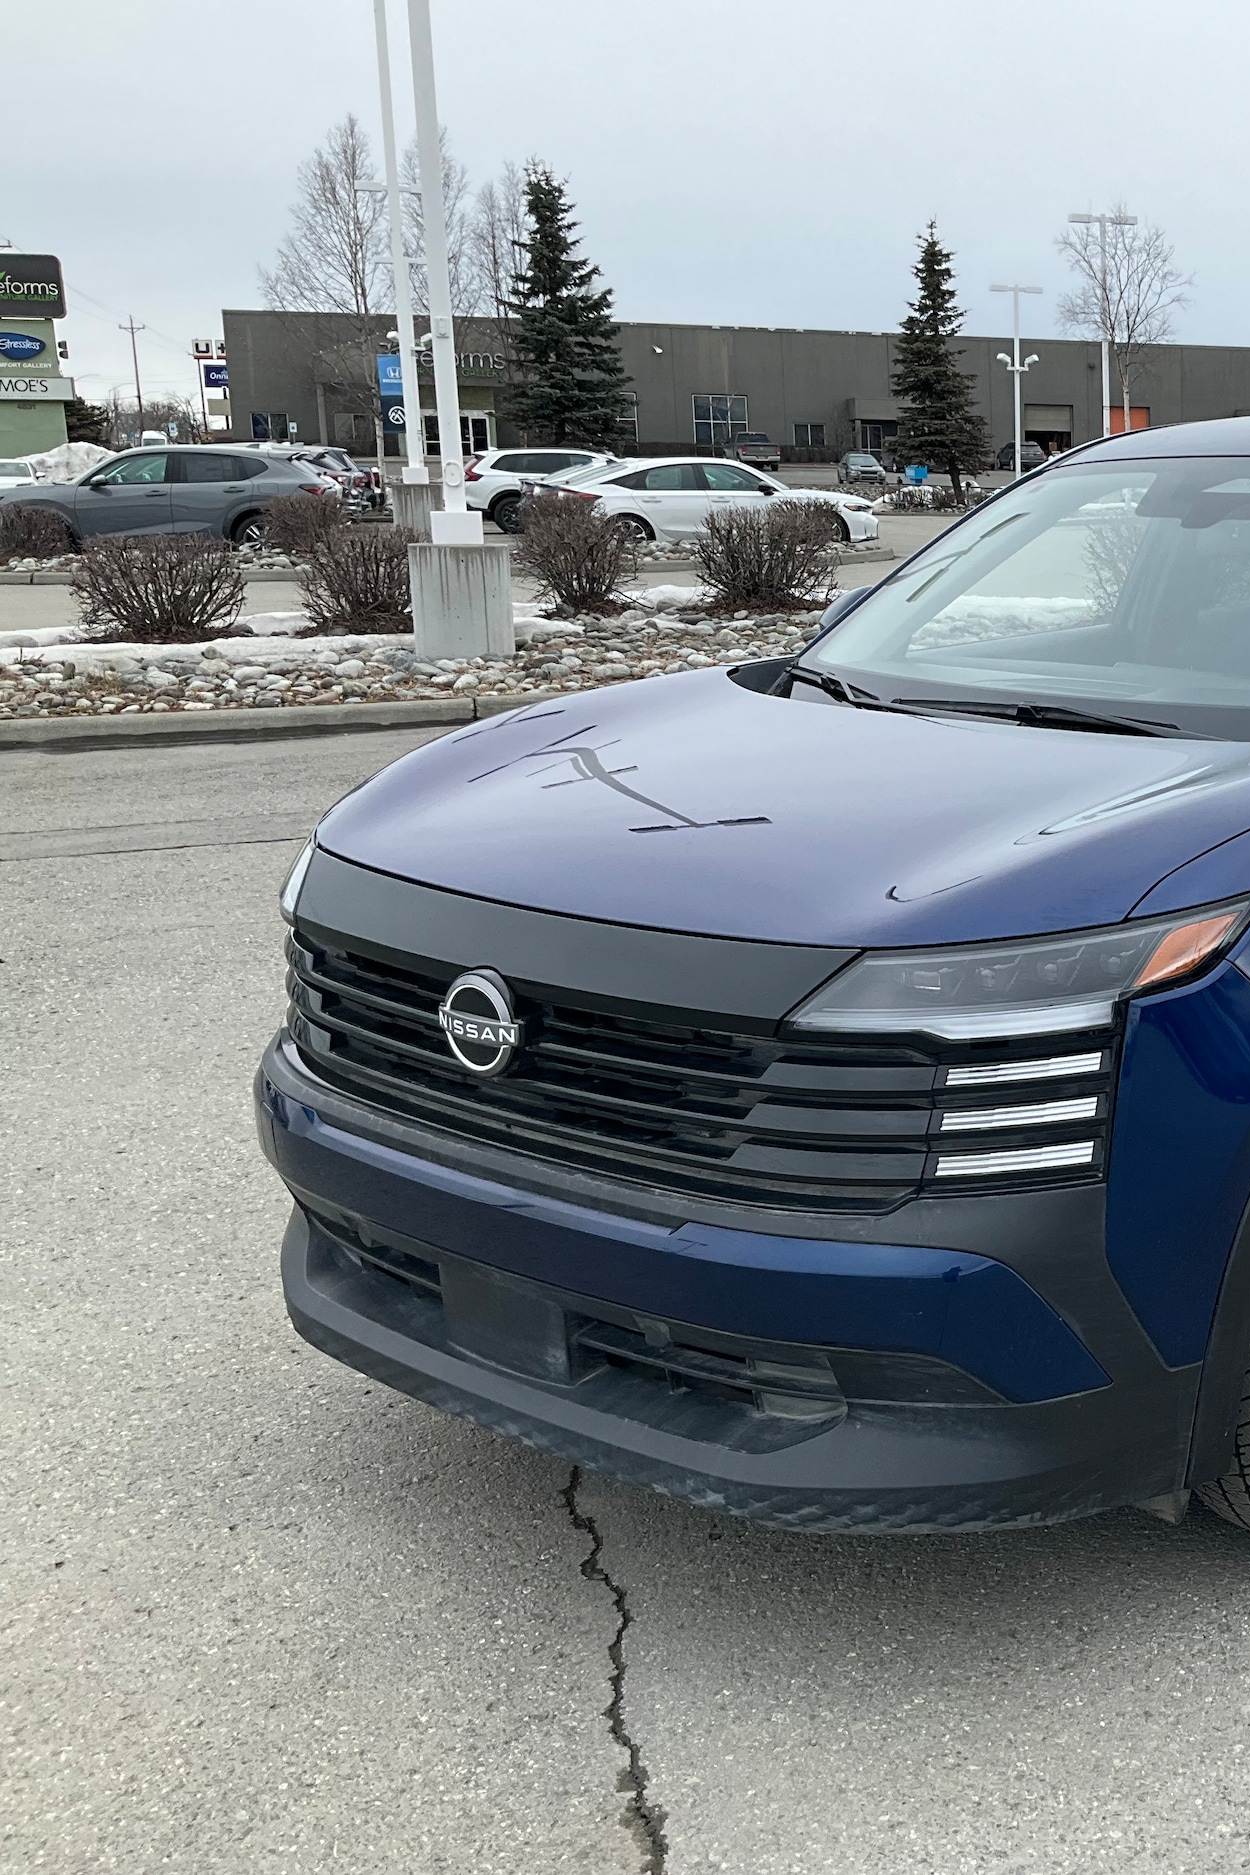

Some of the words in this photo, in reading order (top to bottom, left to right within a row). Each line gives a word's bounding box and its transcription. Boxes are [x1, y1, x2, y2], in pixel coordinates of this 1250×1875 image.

[0, 338, 41, 350] Stressless
[0, 379, 48, 392] MOE'S
[438, 1010, 516, 1044] NISSAN
